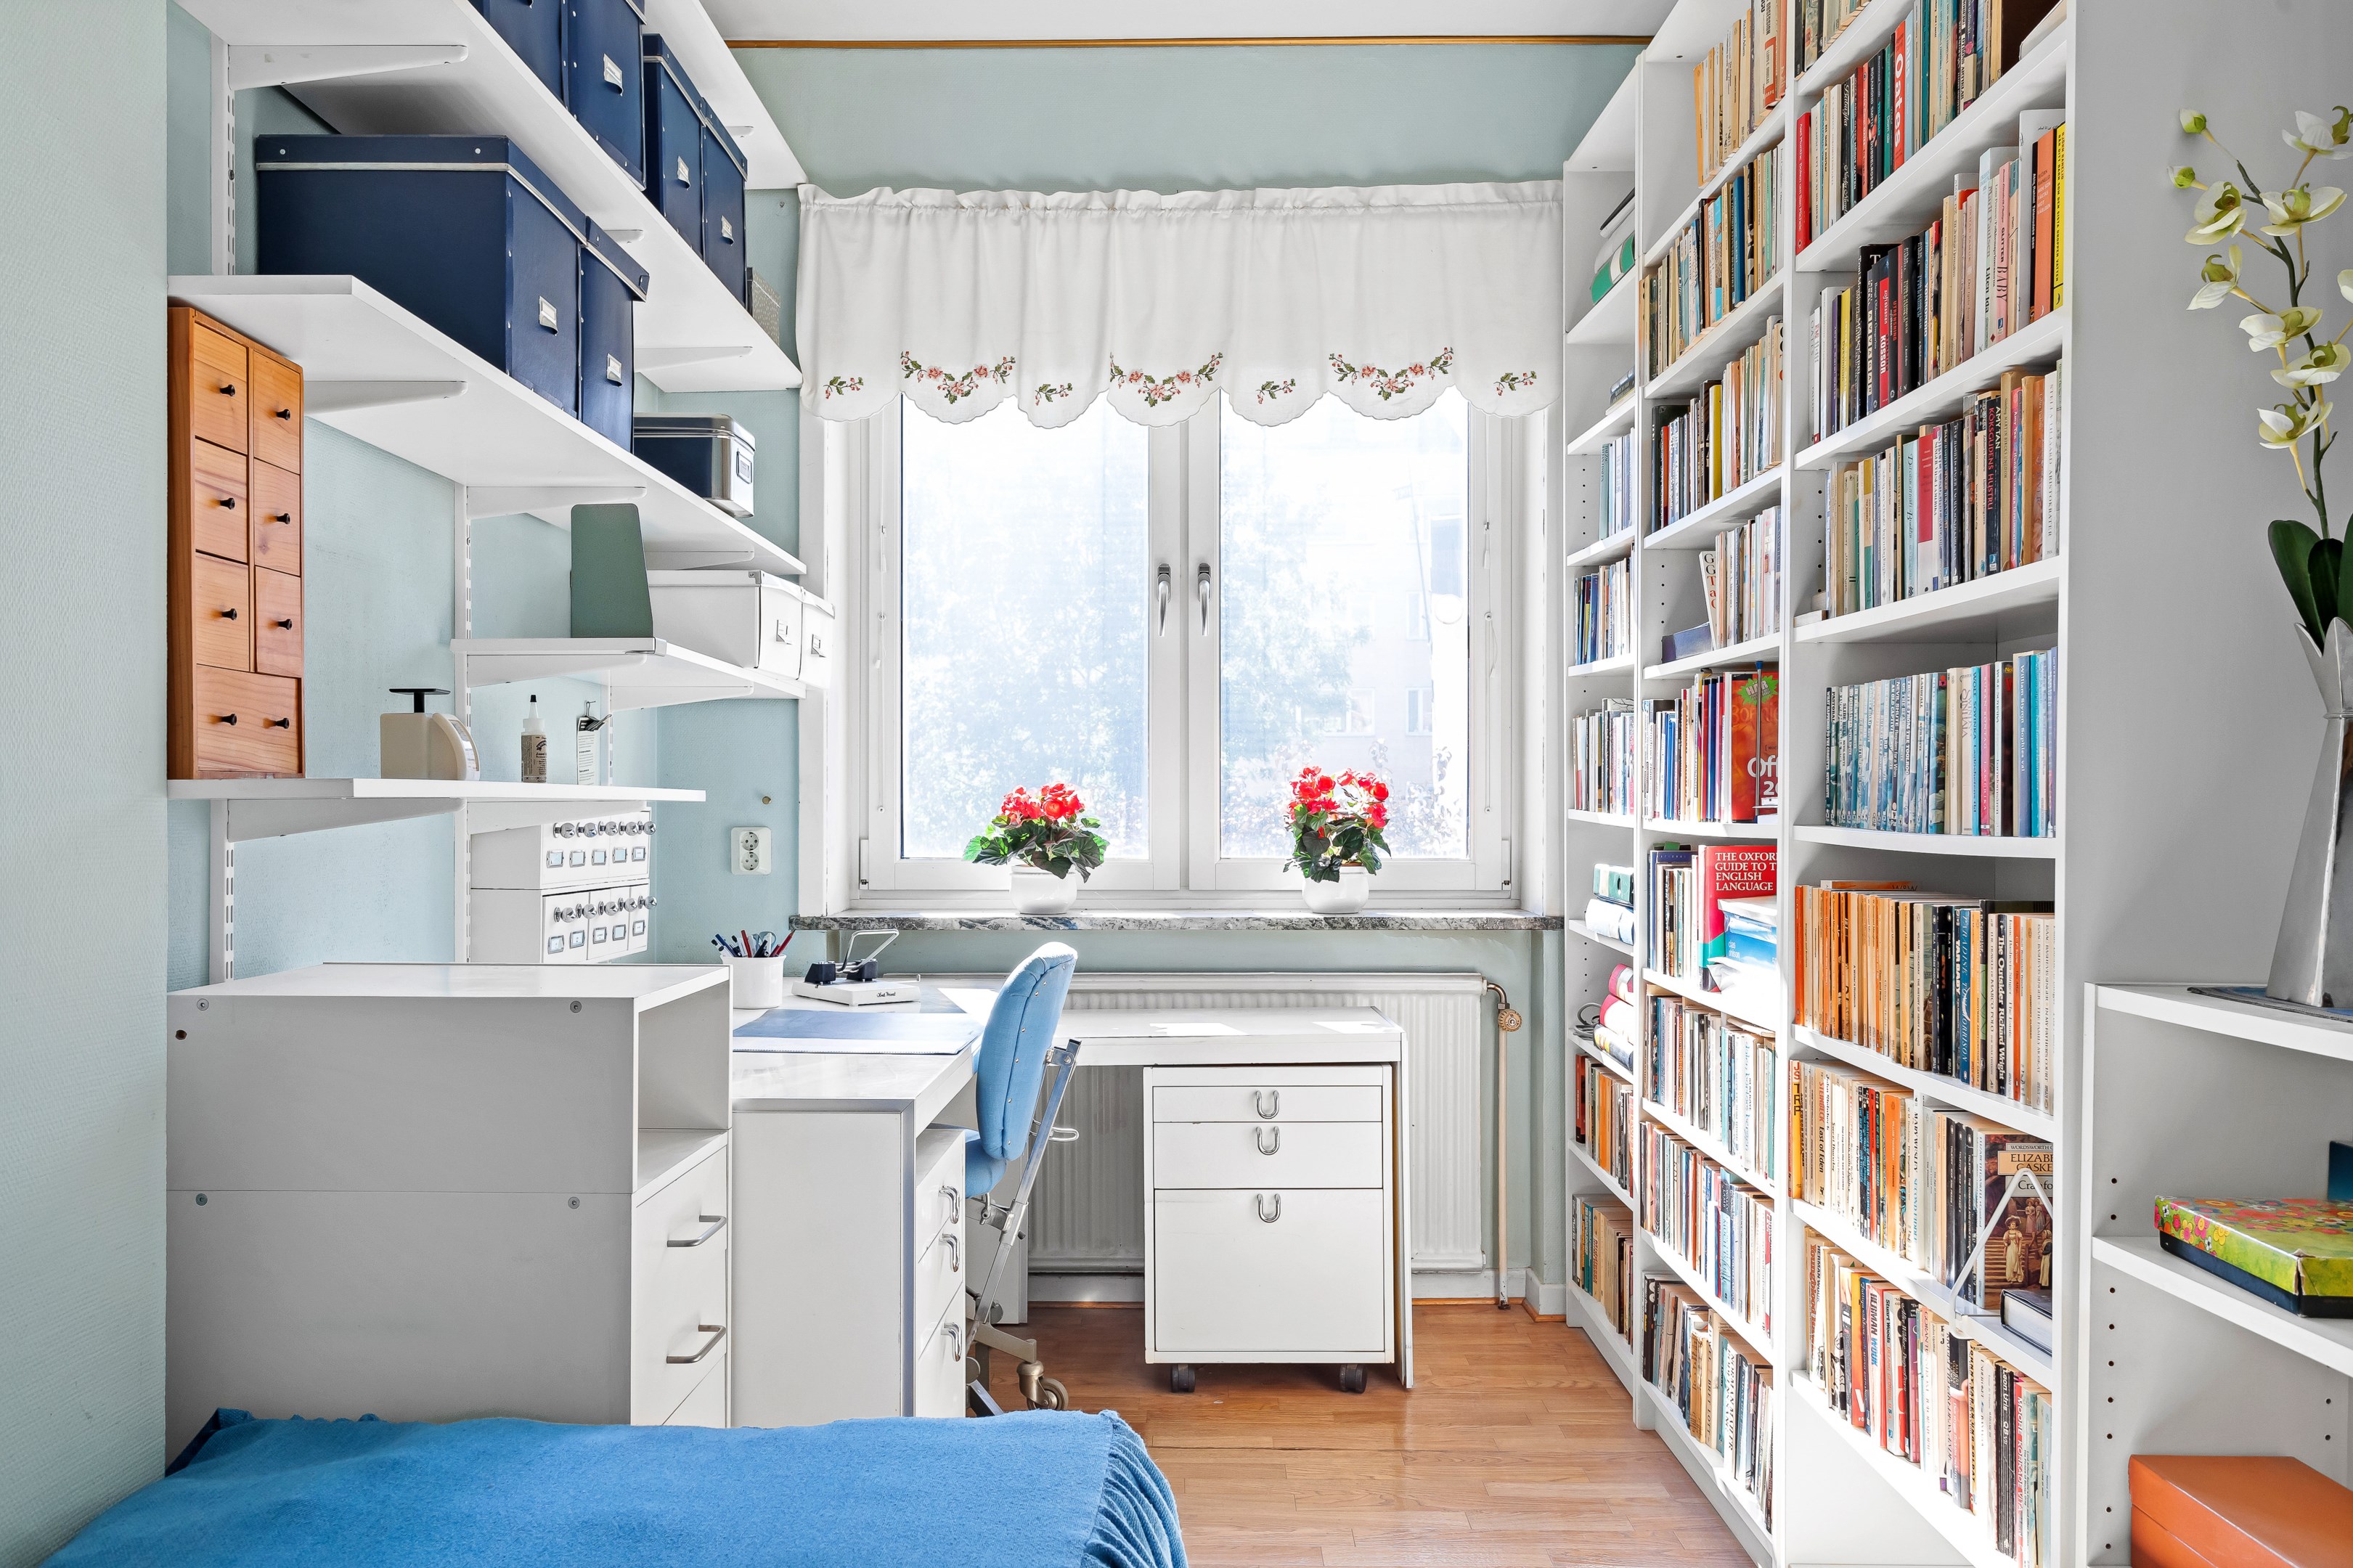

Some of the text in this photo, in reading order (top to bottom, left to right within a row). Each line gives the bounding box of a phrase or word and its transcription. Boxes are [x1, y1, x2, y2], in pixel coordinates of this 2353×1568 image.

[1894, 52, 1904, 147] Oates
[1997, 266, 2008, 302] BABY
[1715, 852, 1777, 861] THE OXFOR
[1715, 862, 1748, 871] GUIDE
[1750, 862, 1767, 871] TO
[1716, 882, 1774, 891] LANGUAGE
[1997, 1047, 2005, 1079] Wright
[2018, 1180, 2053, 1190] Crafo
